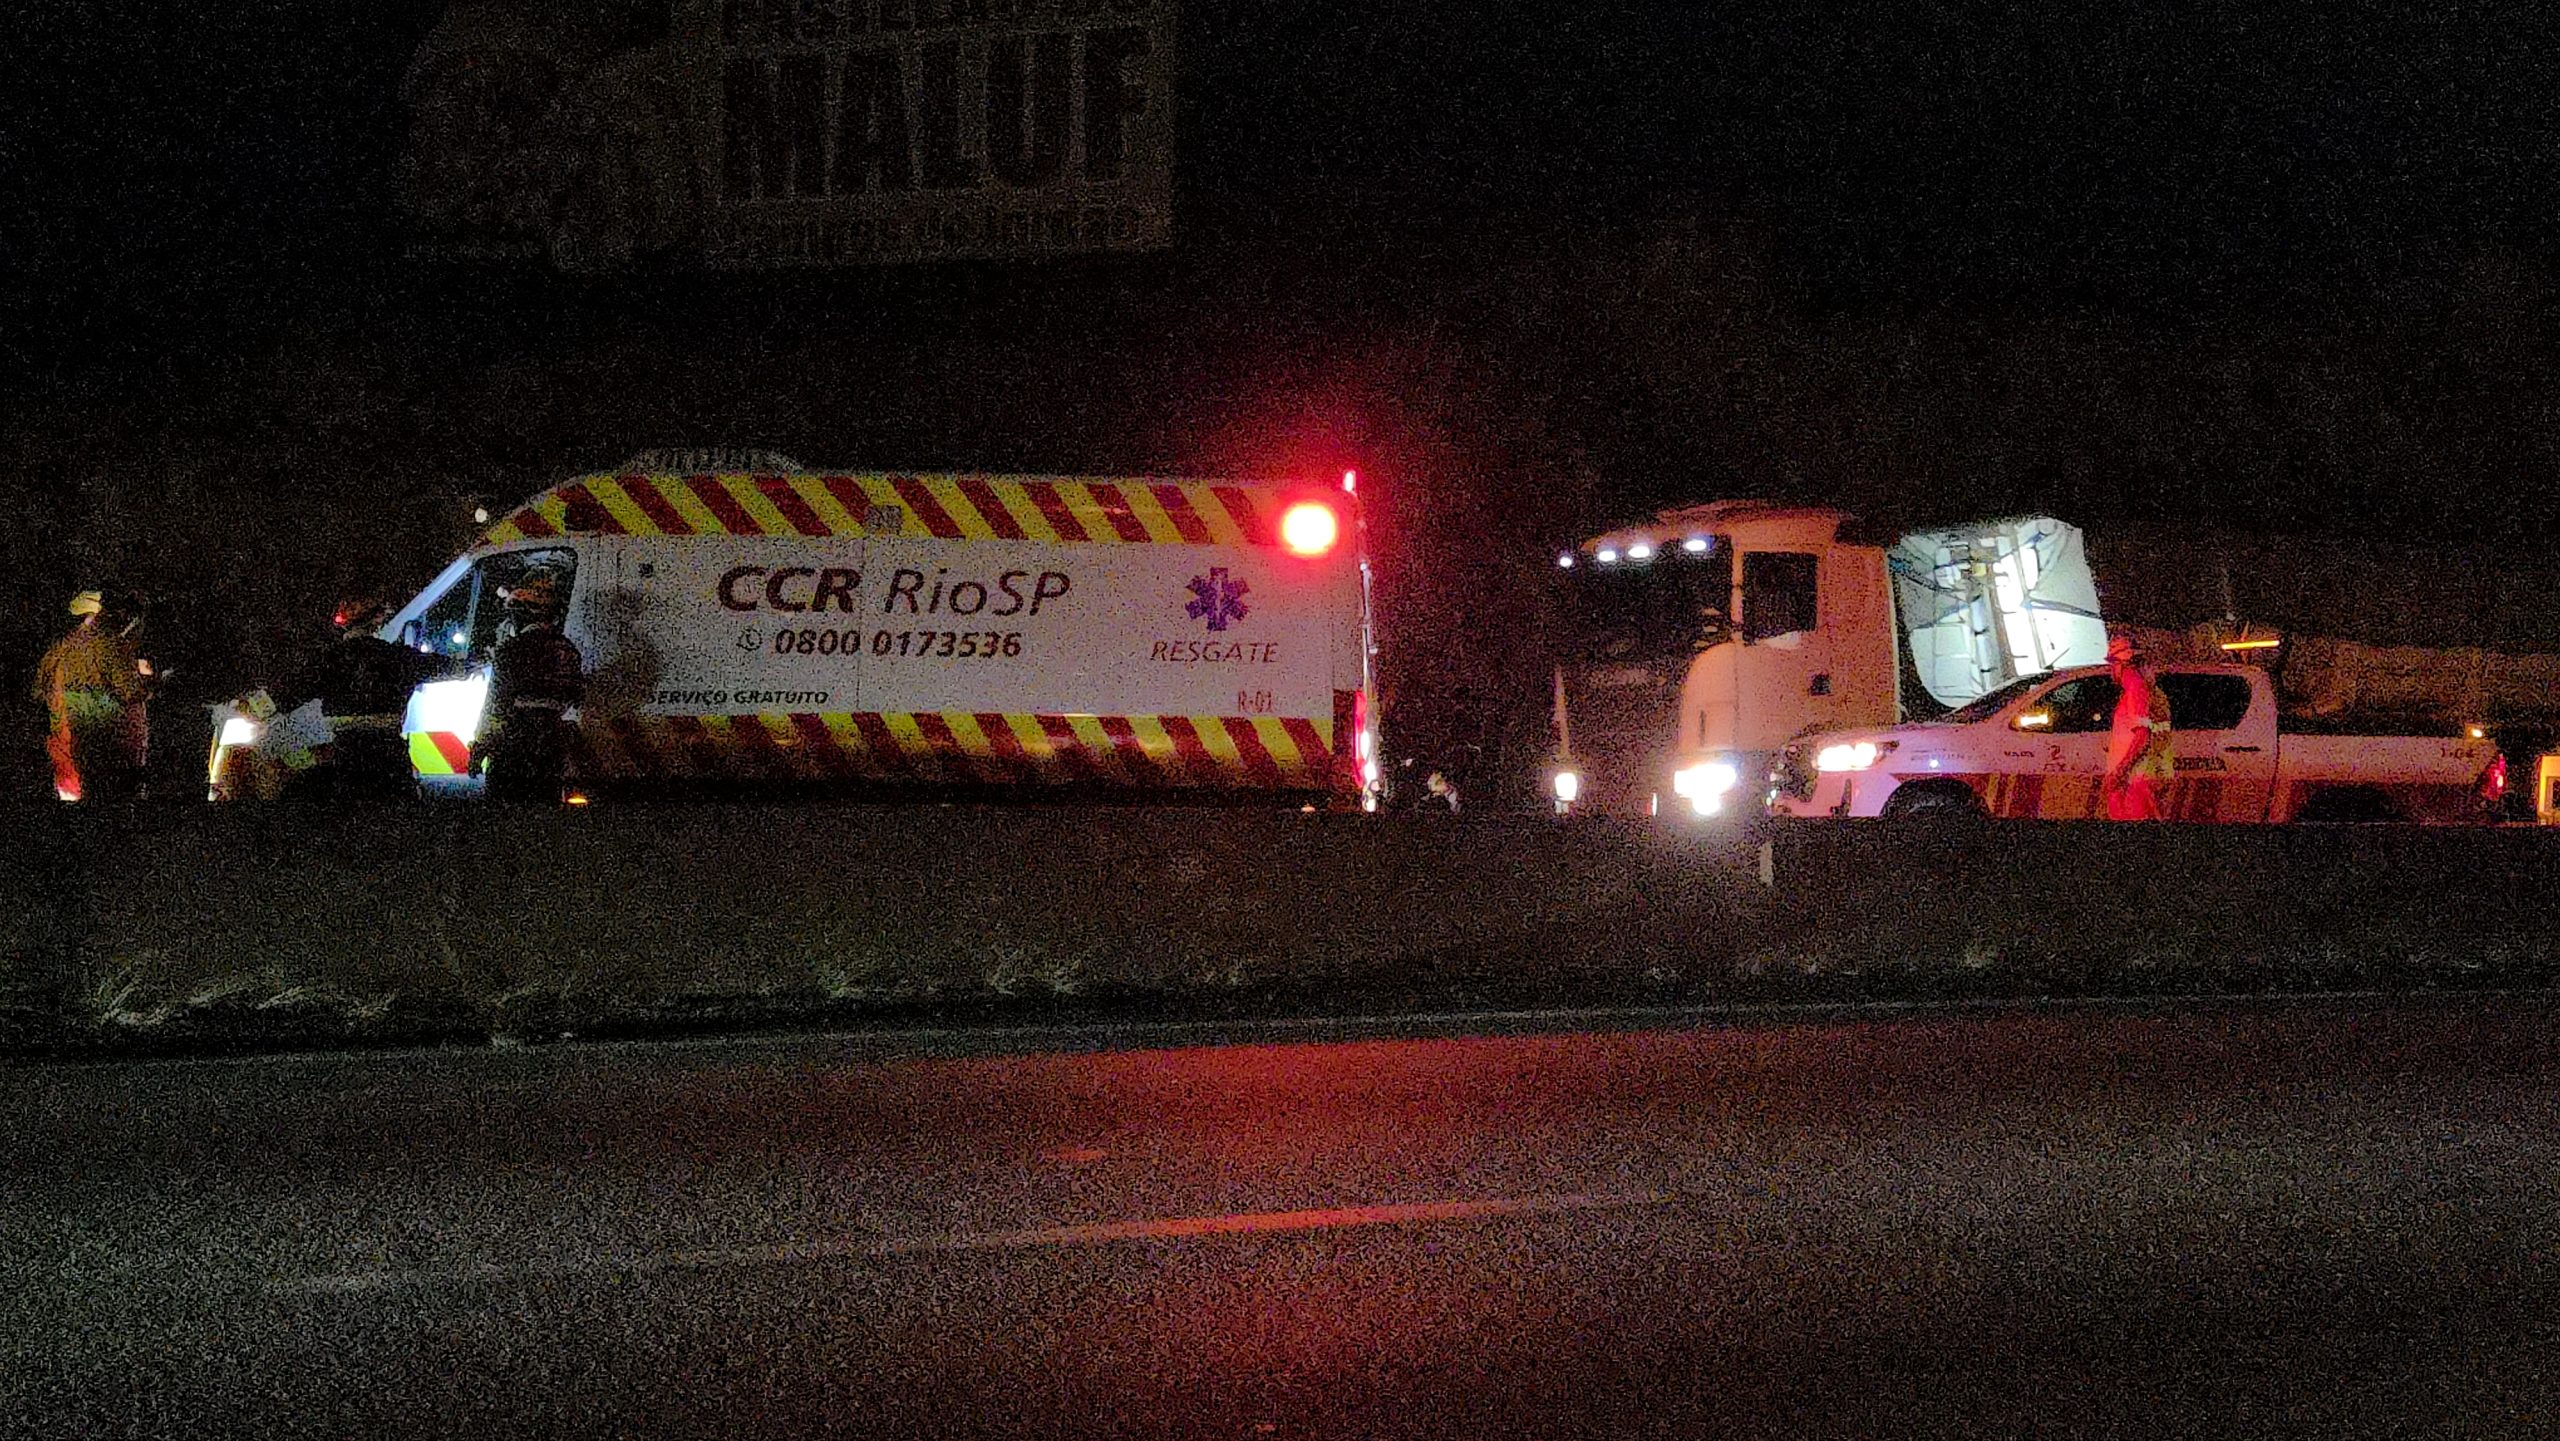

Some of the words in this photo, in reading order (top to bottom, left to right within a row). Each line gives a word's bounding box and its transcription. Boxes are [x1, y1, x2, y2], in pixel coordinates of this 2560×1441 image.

[721, 27, 1152, 200] MALUF
[717, 566, 861, 613] CCR
[884, 568, 1071, 616] RioSP
[774, 629, 861, 657] 0800
[872, 630, 1022, 658] 0173536
[1150, 640, 1279, 664] RESGATE
[733, 690, 829, 705] GRATUITO
